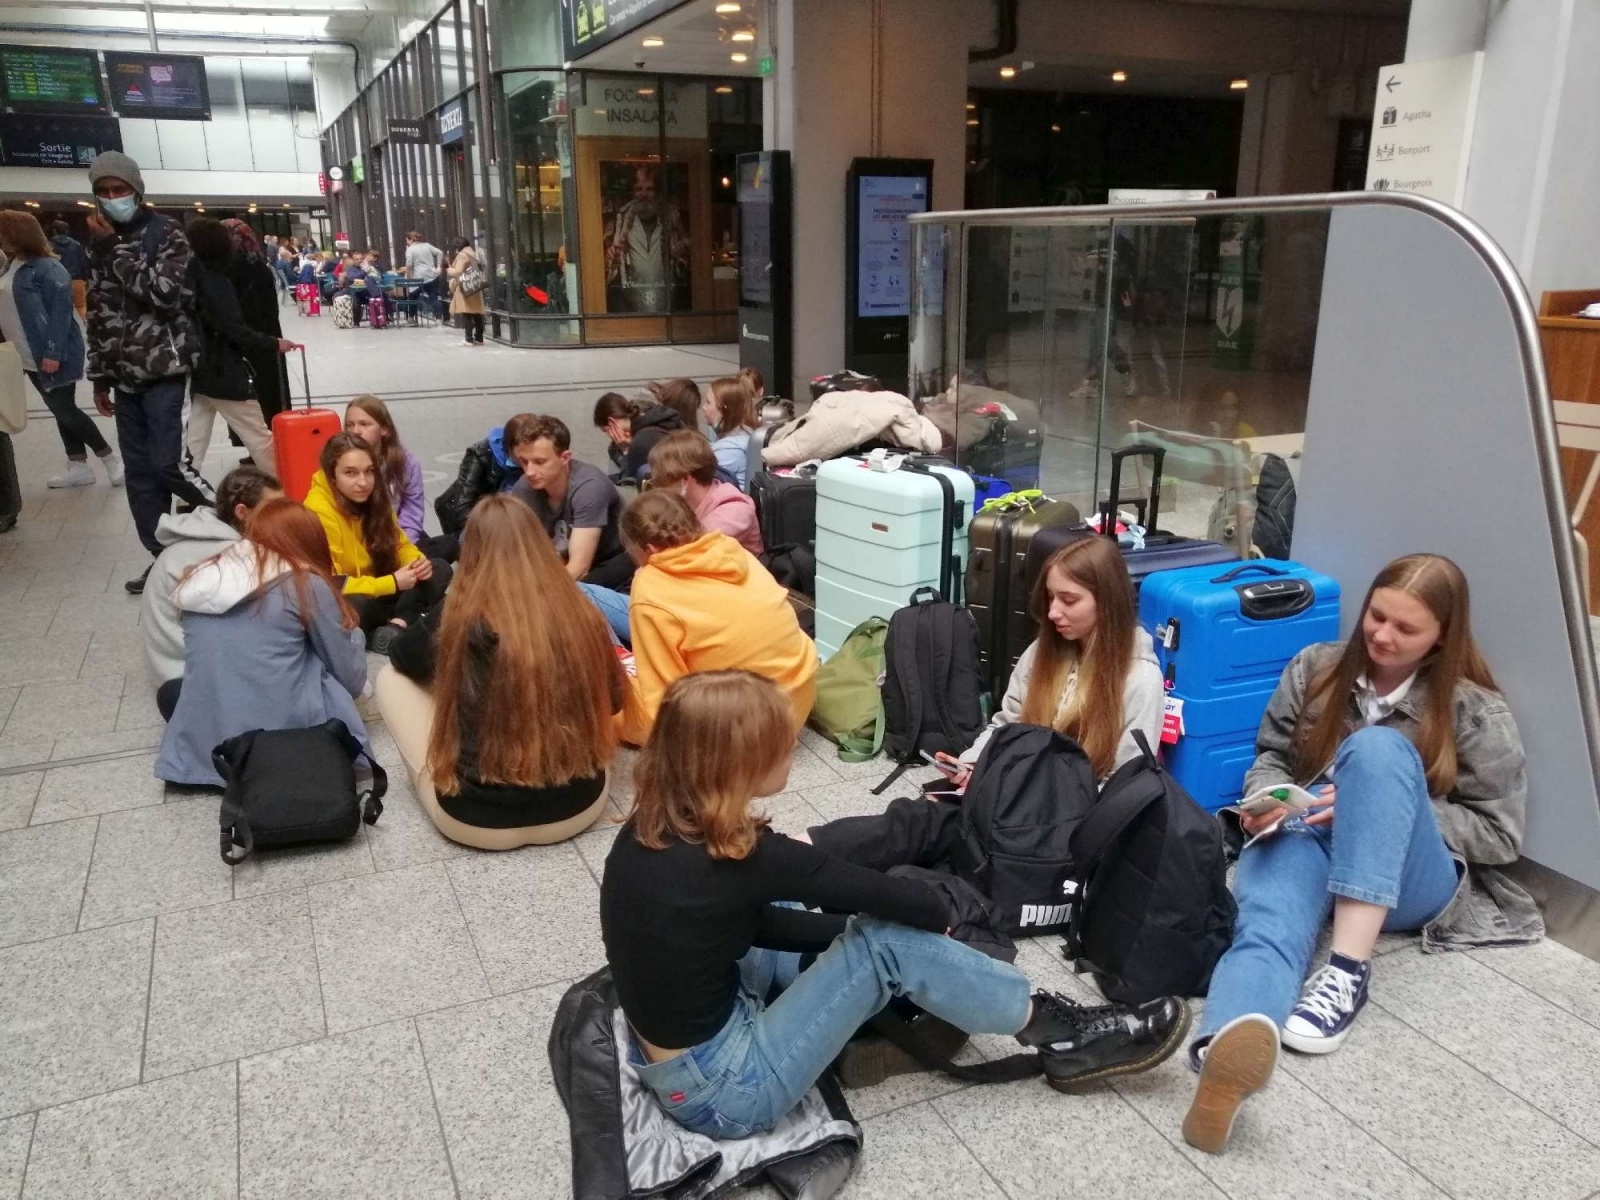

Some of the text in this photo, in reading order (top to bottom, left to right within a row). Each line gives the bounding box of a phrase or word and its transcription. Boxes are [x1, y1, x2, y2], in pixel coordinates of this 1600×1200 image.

[606, 109, 678, 124] INSALAA
[1403, 110, 1432, 122] Agatha
[39, 142, 72, 153] Sortie
[1398, 144, 1431, 156] Bonport
[1393, 179, 1433, 190] Bourgeois
[1019, 903, 1073, 927] PUM
